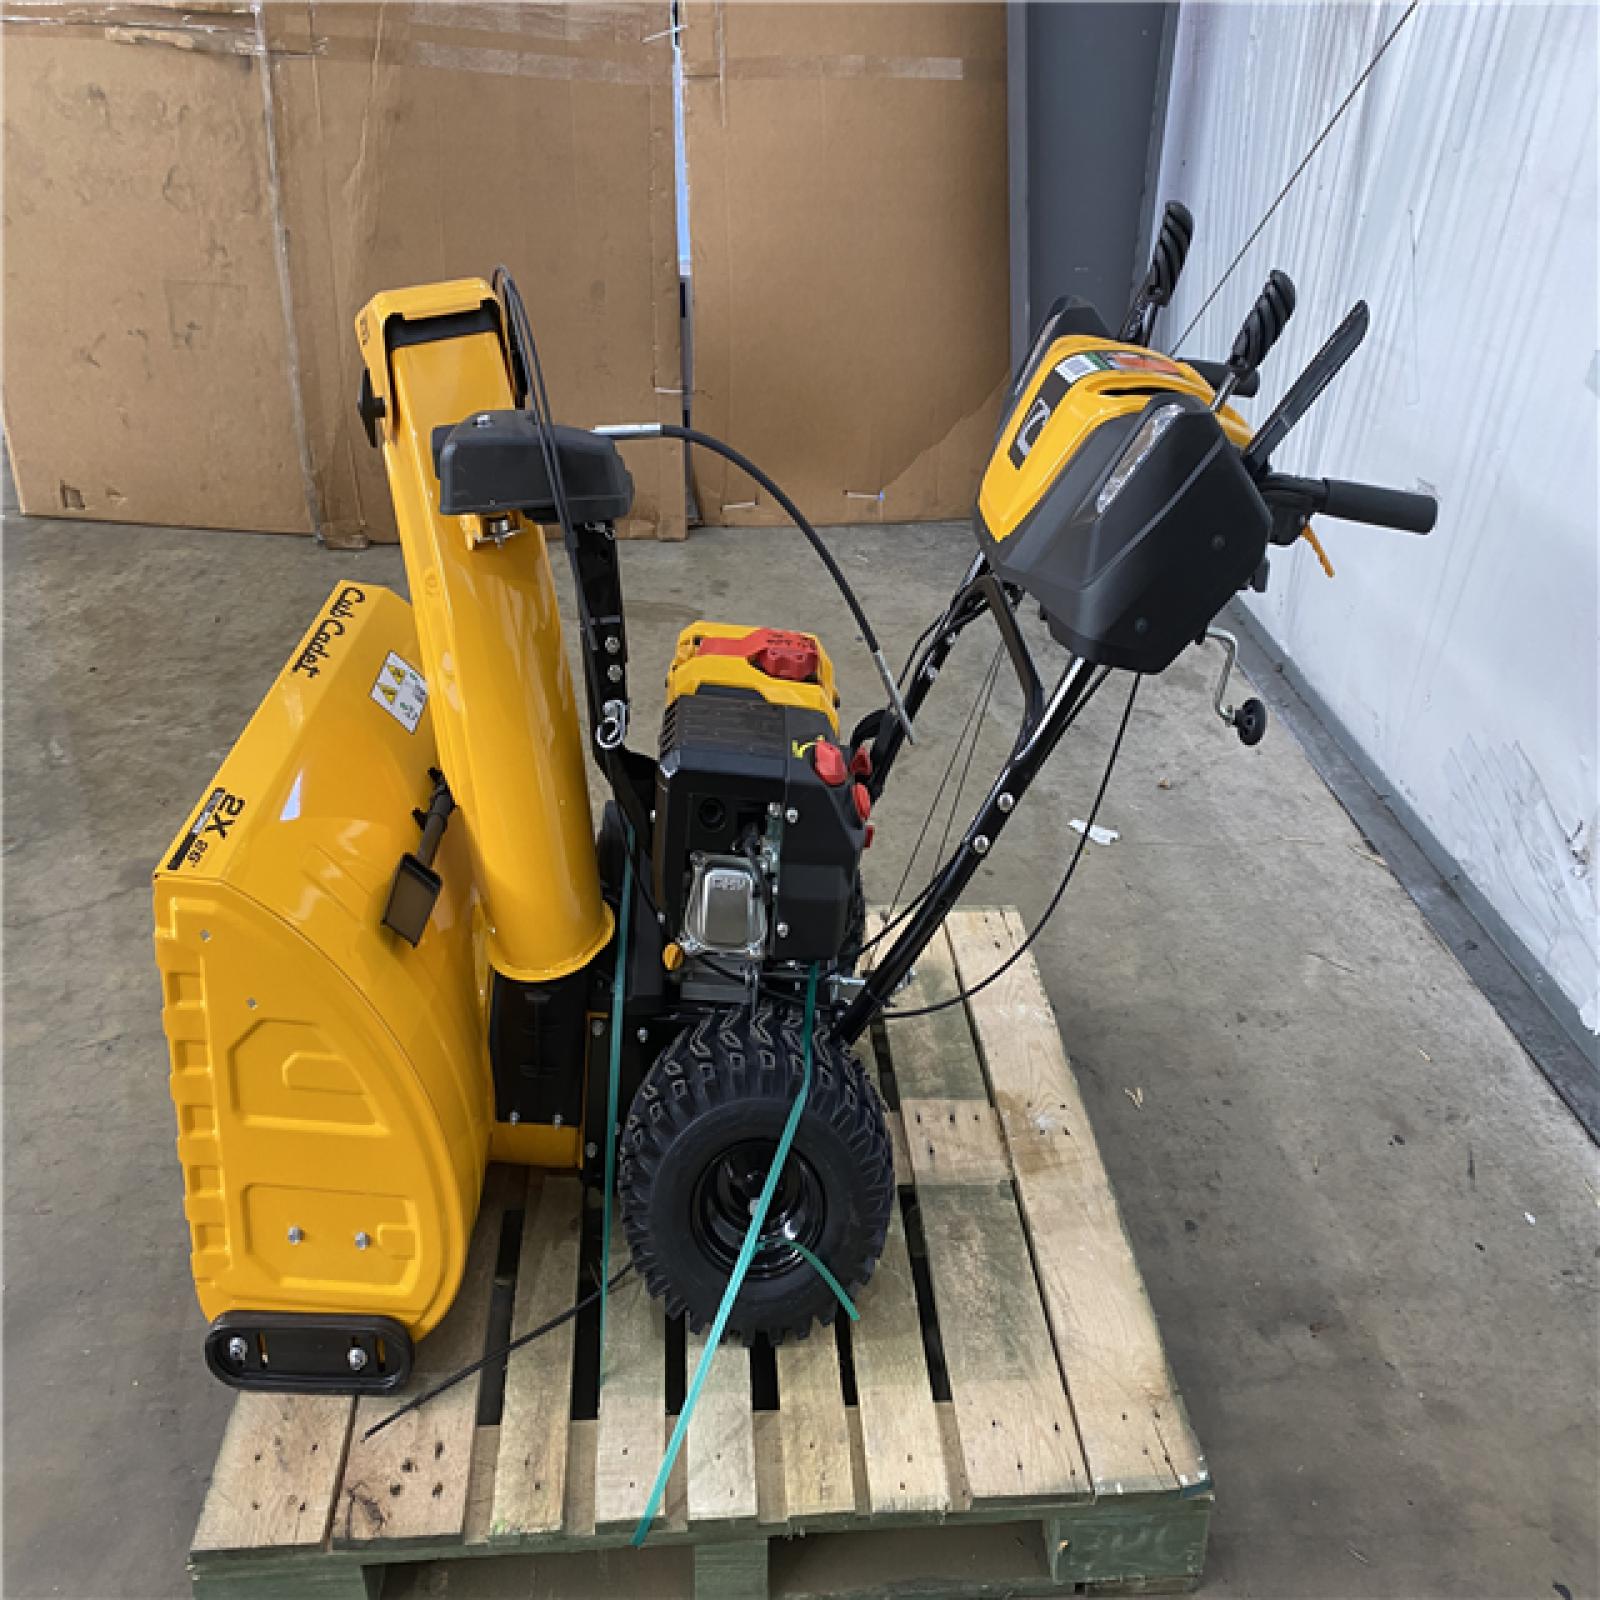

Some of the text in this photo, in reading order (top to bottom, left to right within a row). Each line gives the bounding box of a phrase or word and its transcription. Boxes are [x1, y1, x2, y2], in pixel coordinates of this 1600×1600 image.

[292, 586, 366, 679] Cub Cadet
[204, 794, 246, 840] 2X
